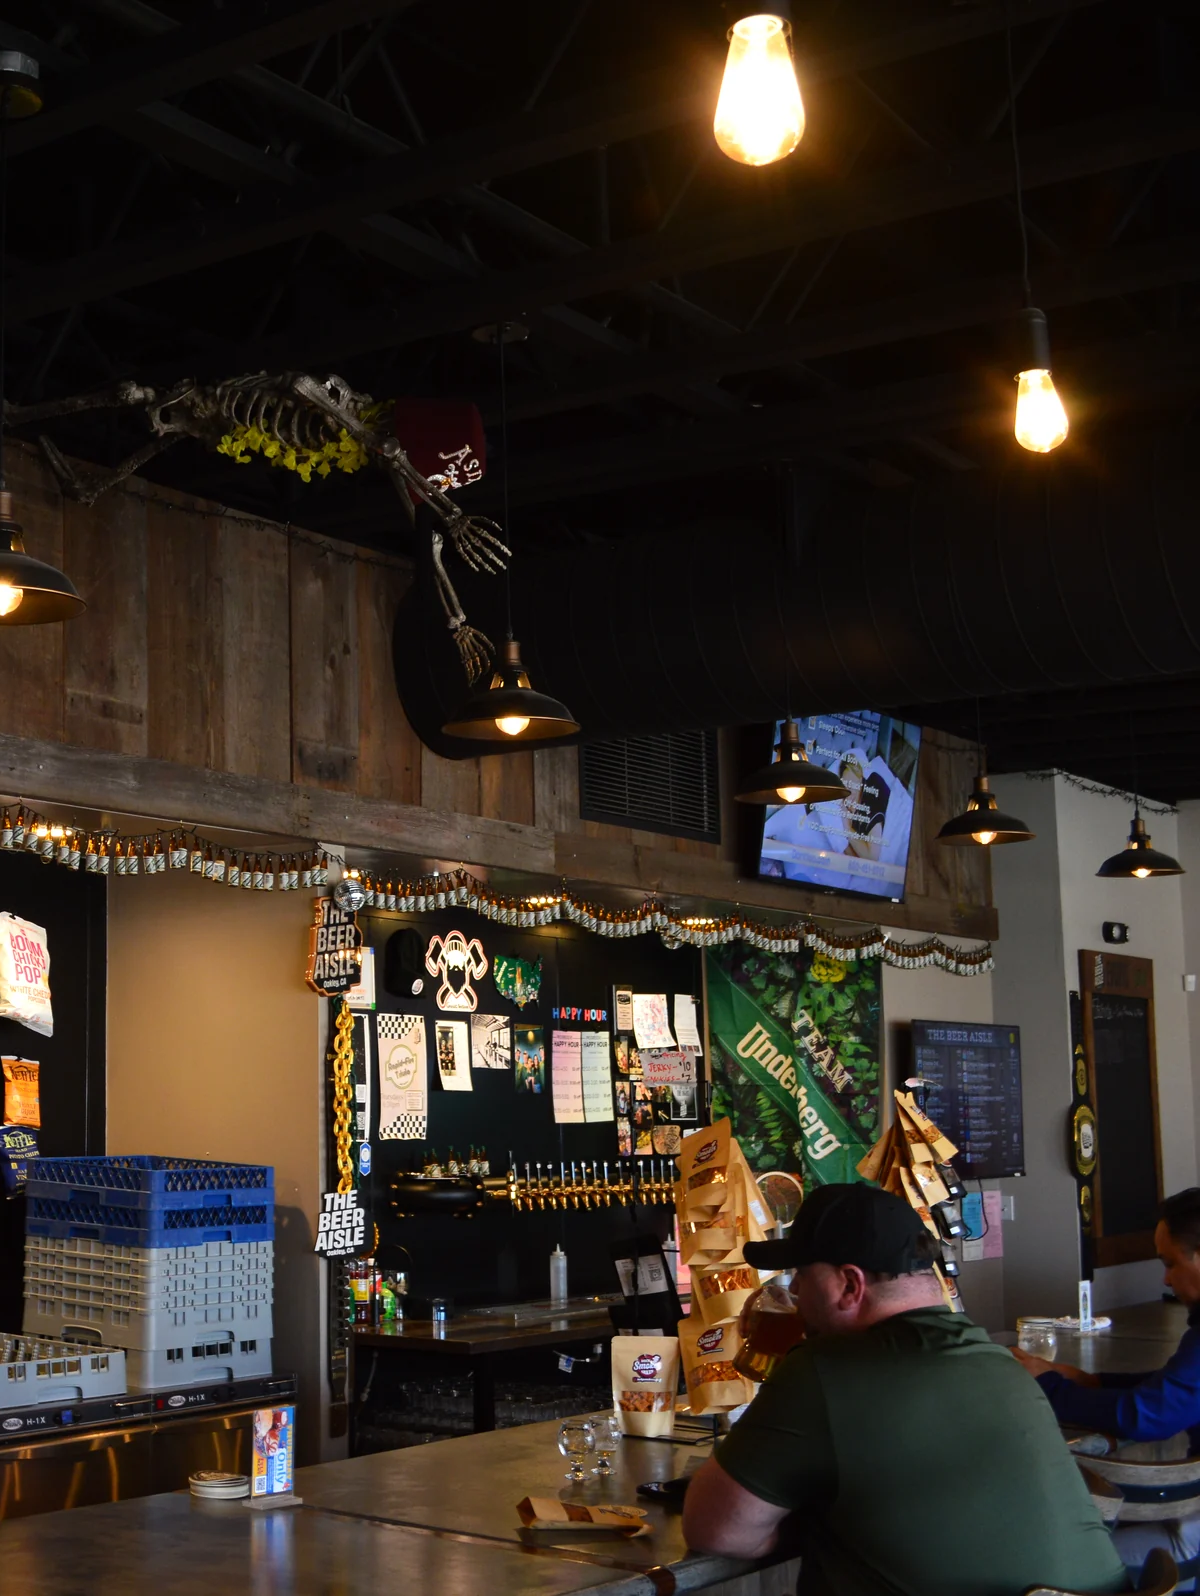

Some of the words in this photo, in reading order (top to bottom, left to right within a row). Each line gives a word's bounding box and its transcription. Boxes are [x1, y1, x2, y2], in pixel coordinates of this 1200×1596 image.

[322, 900, 349, 925] THE
[317, 924, 355, 953] BEER
[14, 962, 41, 985] POP
[313, 949, 355, 981] AISLE
[323, 980, 340, 989] Oakley,
[340, 977, 347, 986] CA
[552, 1006, 582, 1021] HAPPY
[584, 1009, 607, 1022] HOUR
[927, 1028, 945, 1041] THE
[946, 1030, 969, 1042] BEER
[969, 1031, 993, 1043] AISLE
[791, 1009, 854, 1094] TEAM
[678, 1061, 692, 1072] $10
[681, 1073, 692, 1083] $7
[736, 1021, 842, 1161] Underberg
[323, 1189, 358, 1212] THE
[318, 1207, 365, 1232] BEER
[314, 1226, 365, 1252] AISLE
[326, 1248, 346, 1257] Oakley,
[346, 1246, 355, 1255] CA
[188, 1393, 205, 1402] H-1X
[26, 1416, 47, 1426] H-1X
[275, 1452, 286, 1484] Only
